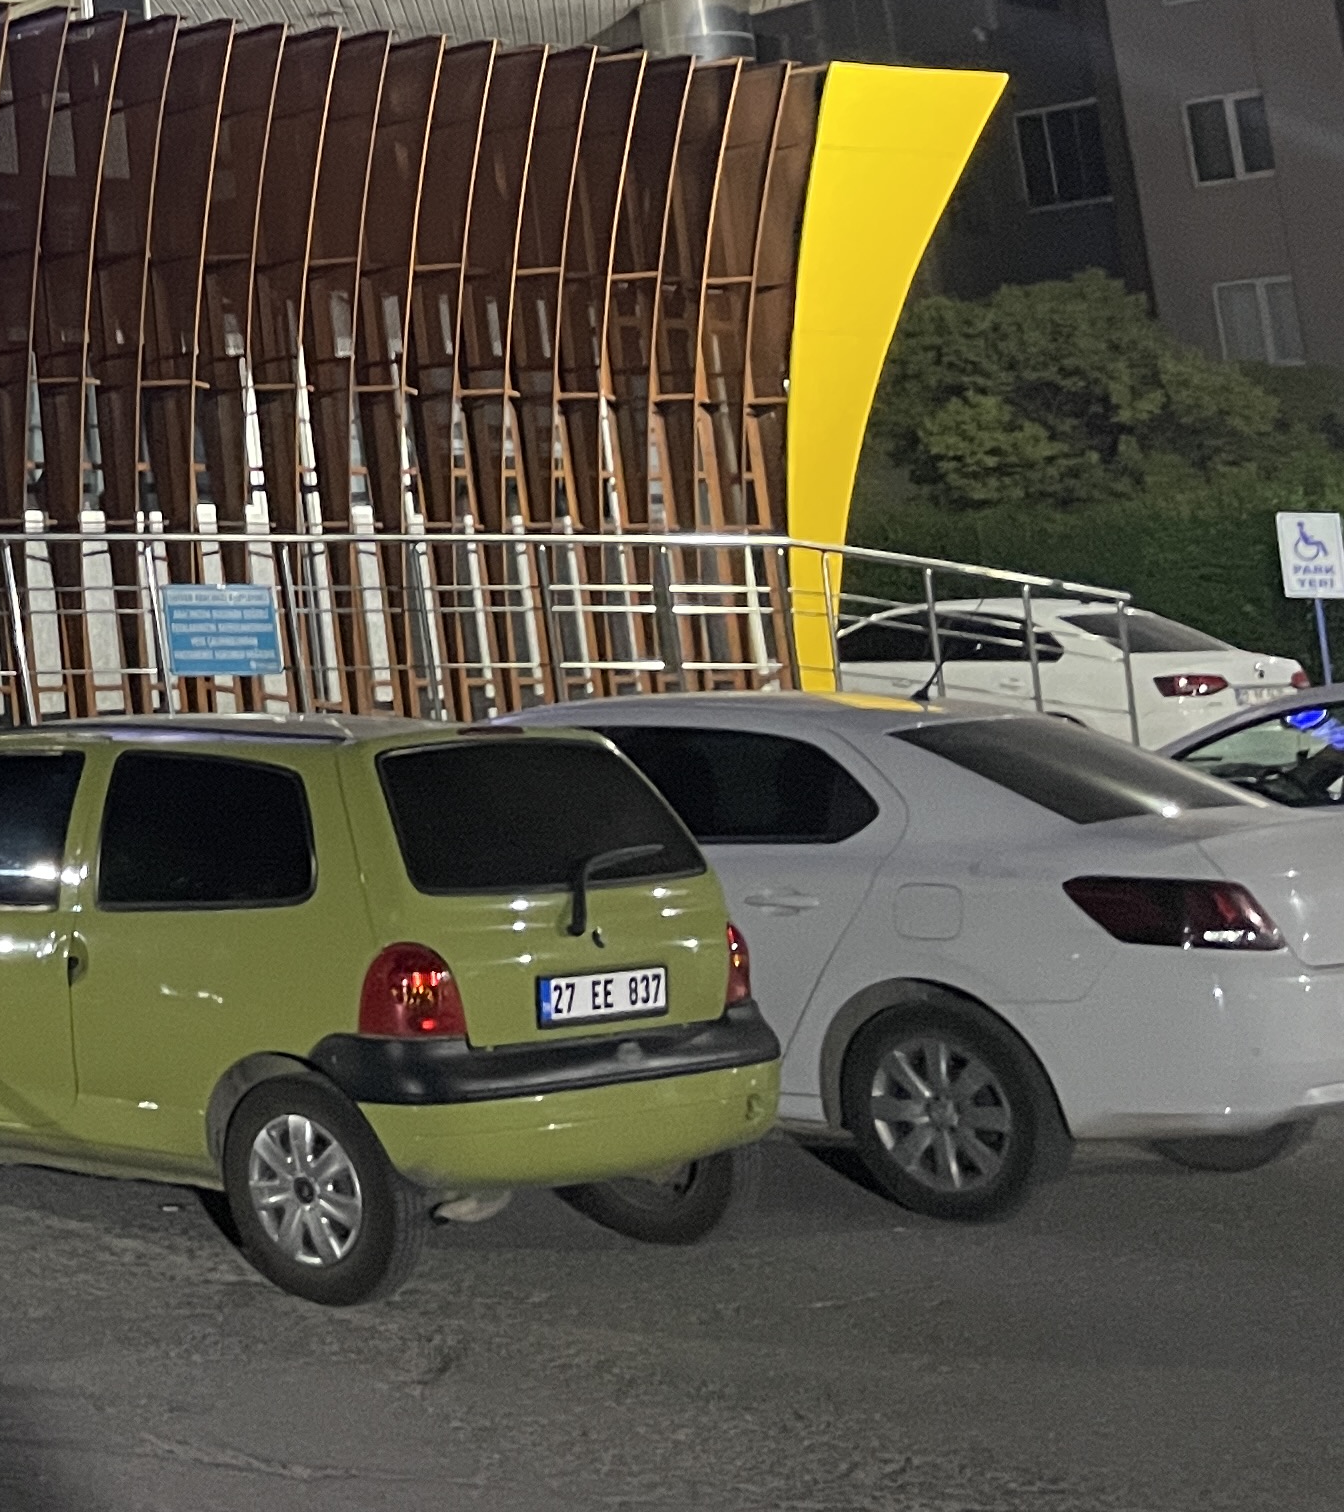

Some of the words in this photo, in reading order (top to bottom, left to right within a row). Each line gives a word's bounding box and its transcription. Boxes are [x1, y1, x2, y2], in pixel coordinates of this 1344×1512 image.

[553, 983, 576, 1014] 27
[591, 978, 614, 1010] EE
[628, 973, 662, 1006] 837
